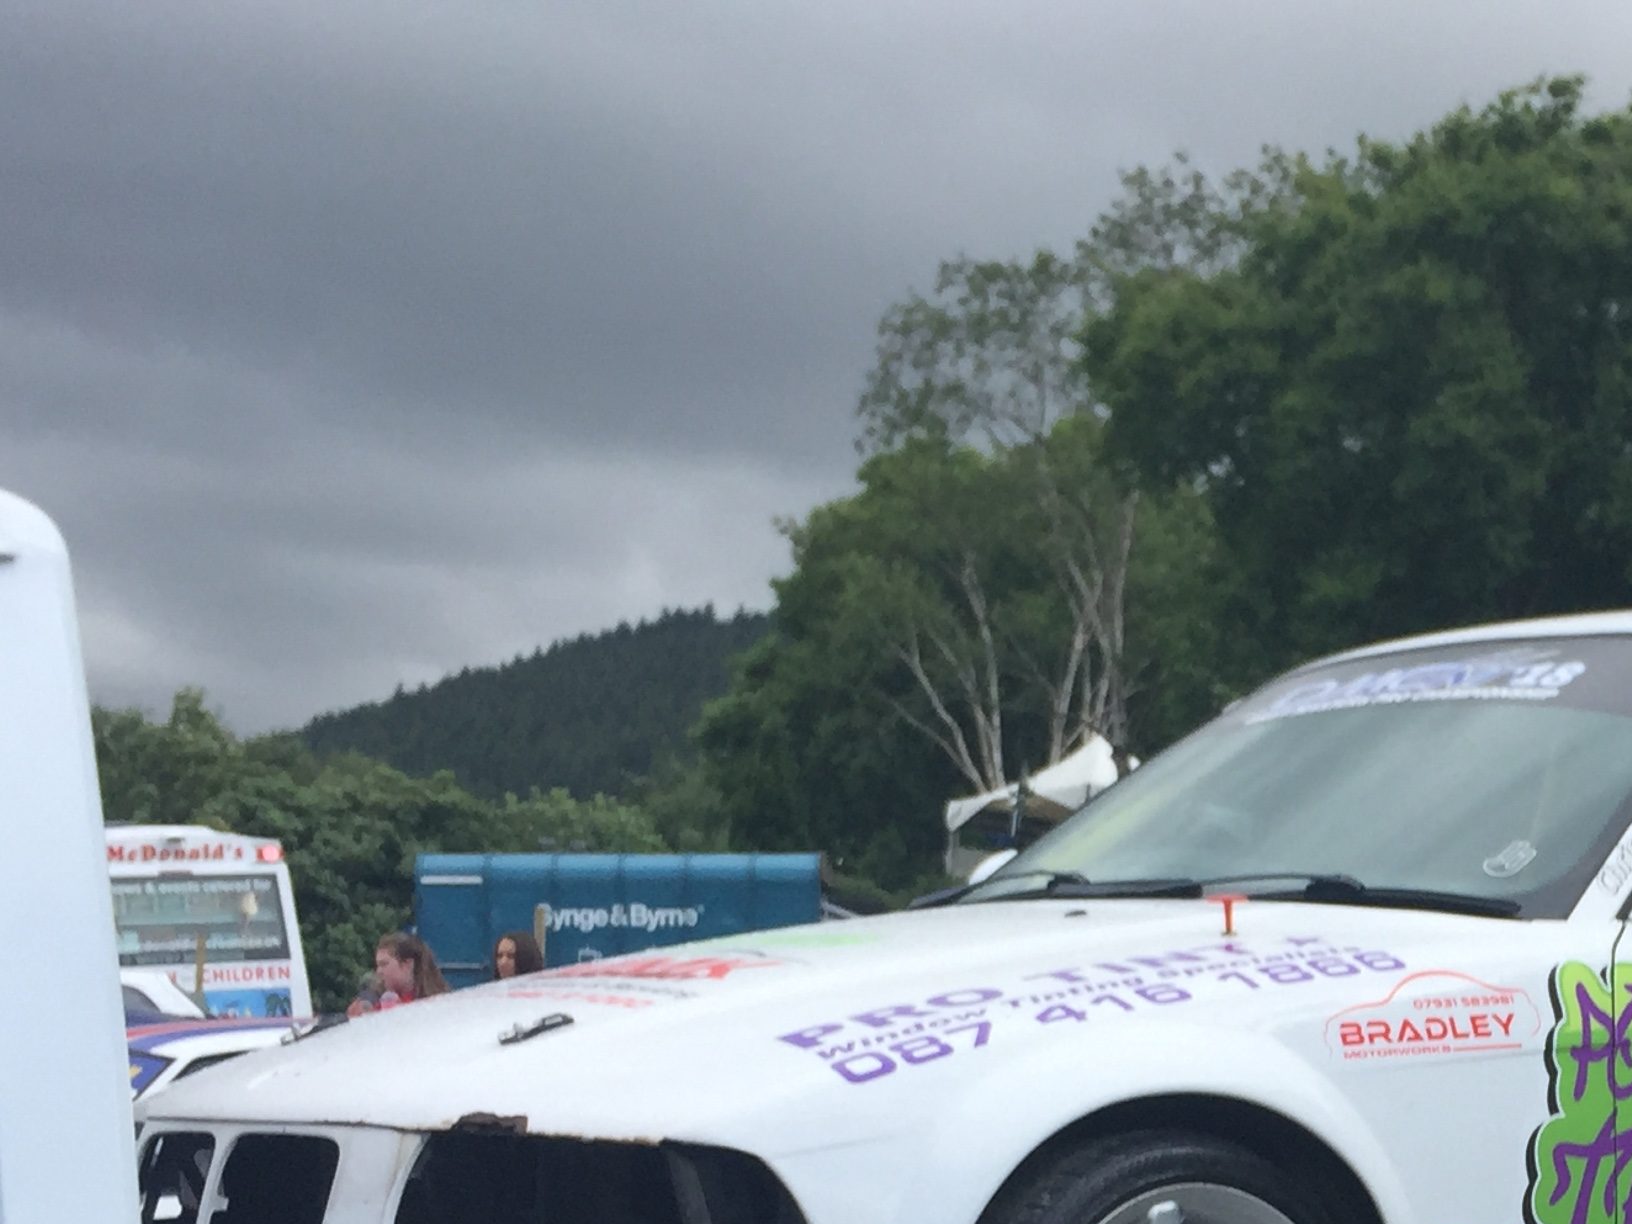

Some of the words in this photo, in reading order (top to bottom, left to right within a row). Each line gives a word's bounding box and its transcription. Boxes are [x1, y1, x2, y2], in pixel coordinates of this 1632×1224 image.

[107, 843, 243, 862] McDonald's
[203, 965, 291, 984] CHILDREN
[777, 987, 1002, 1049] PRO
[816, 1009, 987, 1059] Window
[830, 1020, 992, 1084] 087
[1035, 984, 1193, 1024] 416
[1339, 1013, 1515, 1046] BRADLEY
[1343, 1046, 1451, 1060] MOTORWORKS
